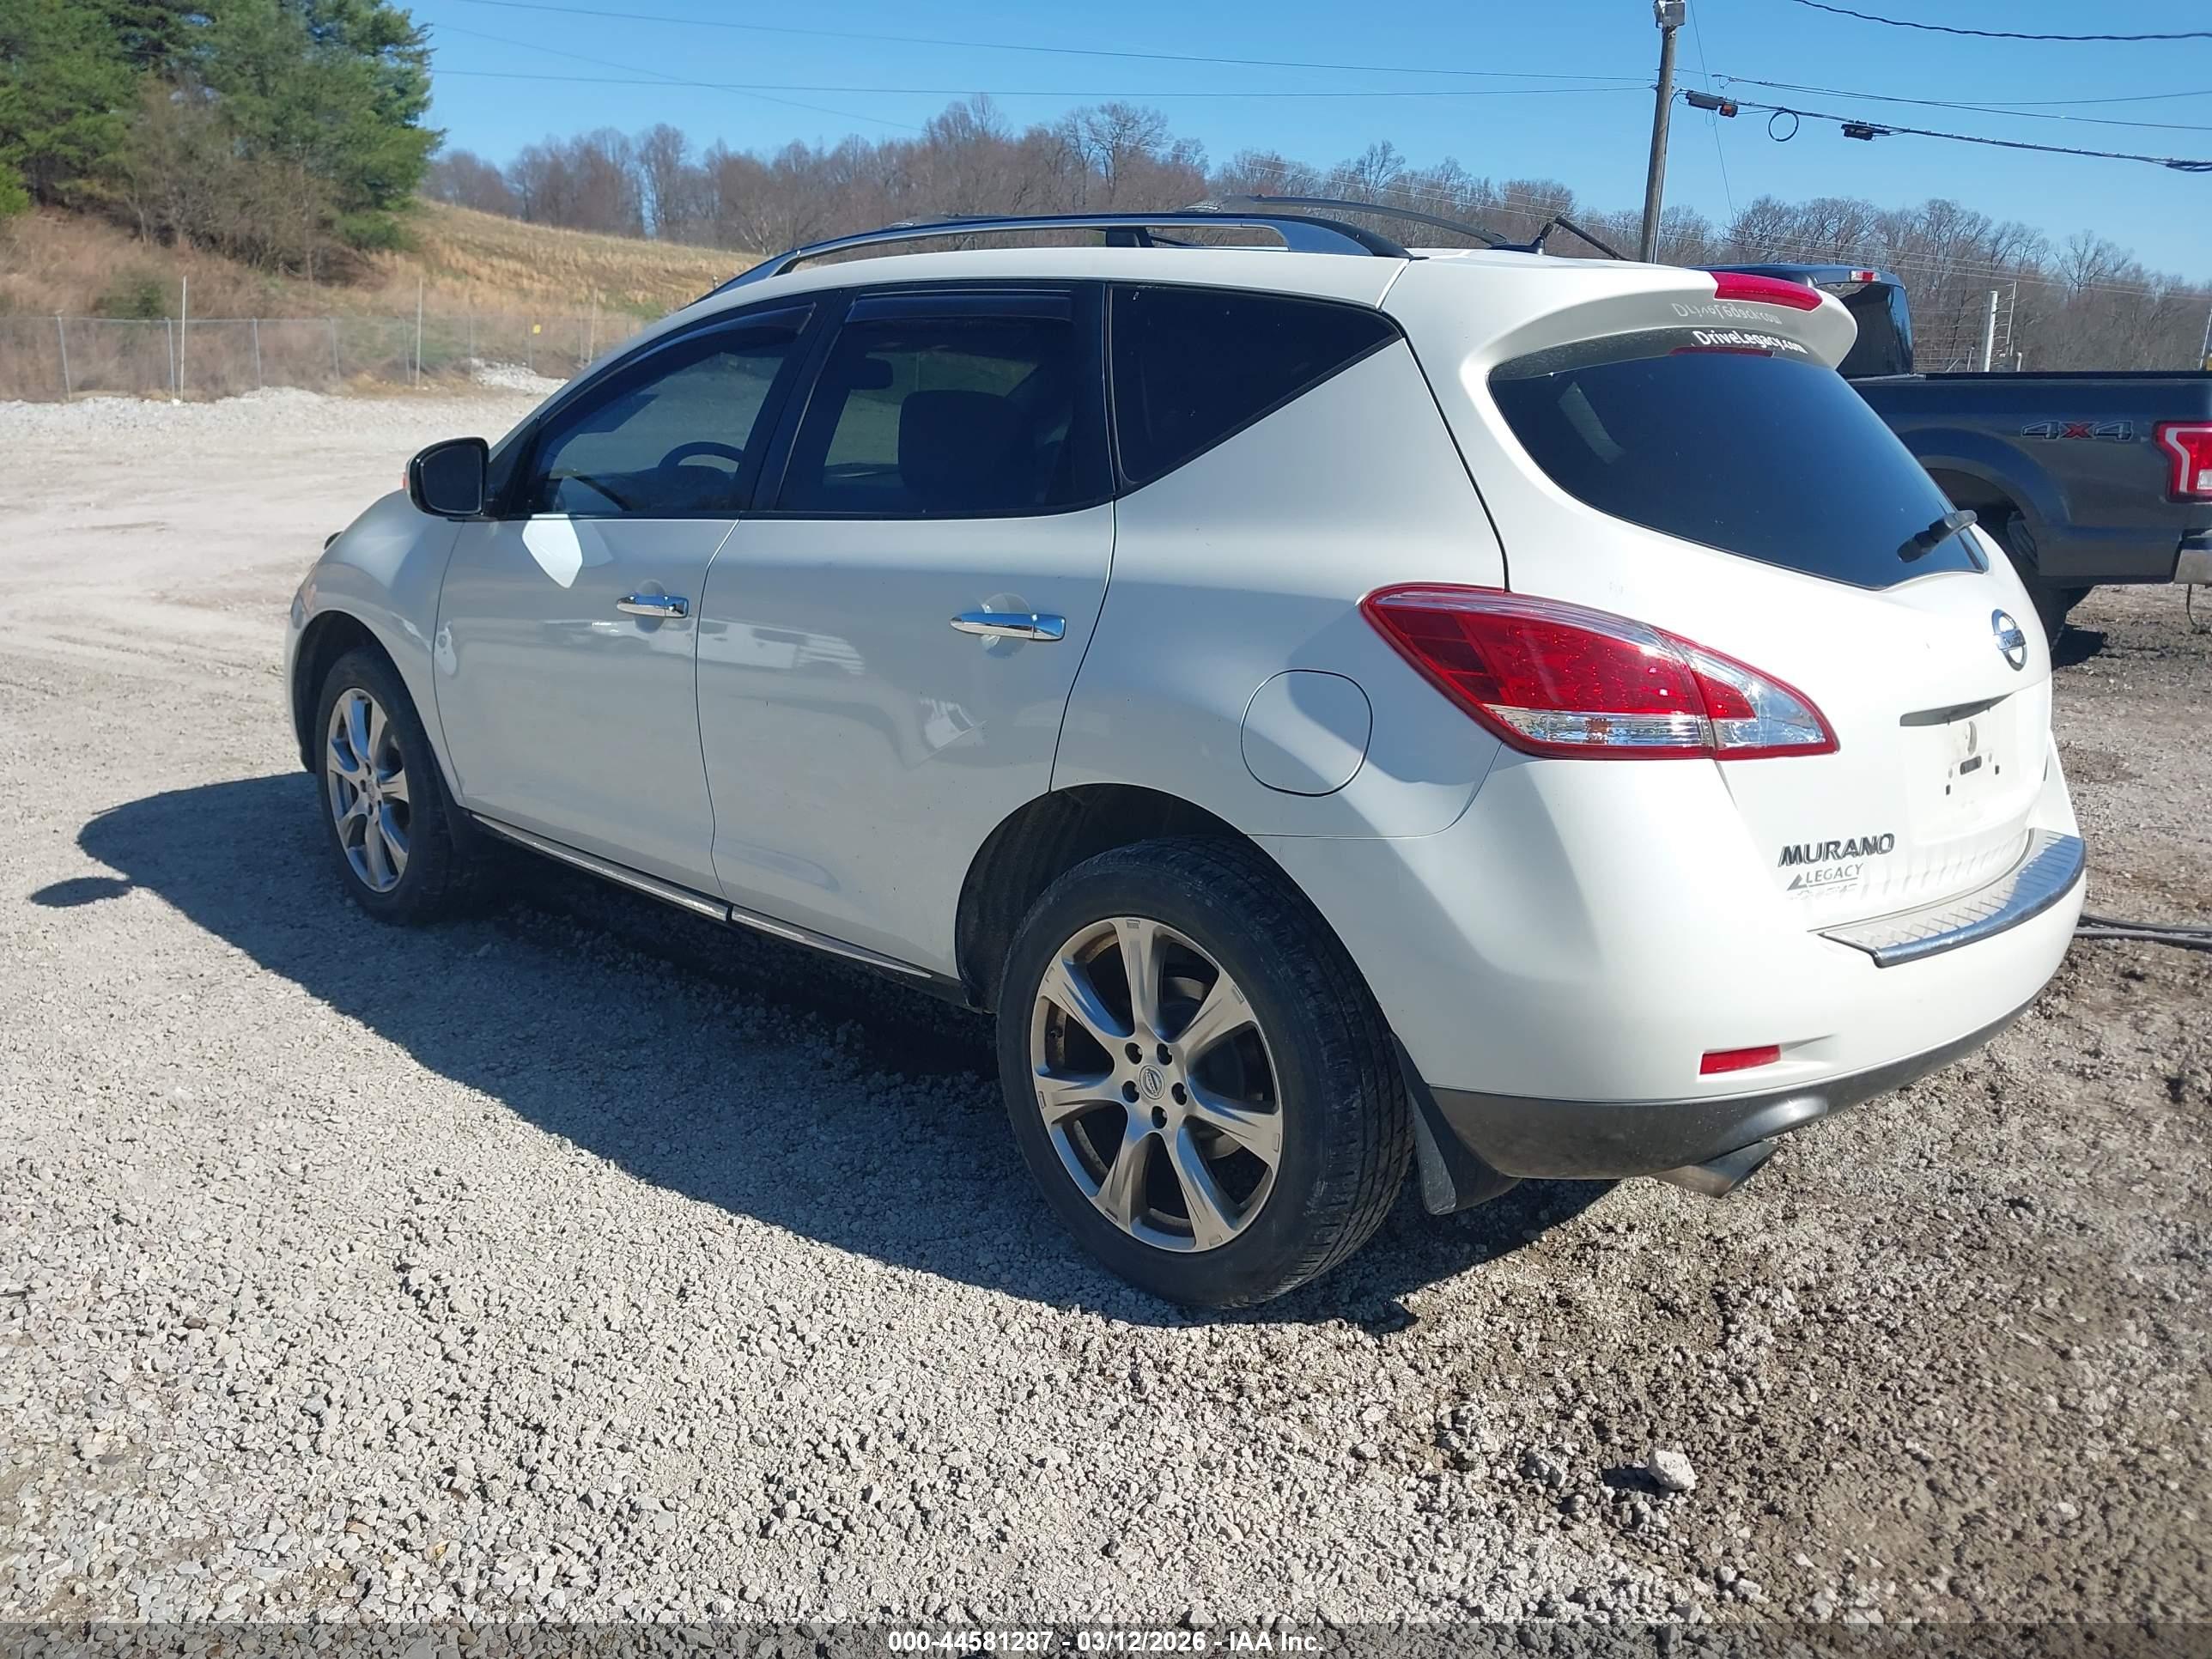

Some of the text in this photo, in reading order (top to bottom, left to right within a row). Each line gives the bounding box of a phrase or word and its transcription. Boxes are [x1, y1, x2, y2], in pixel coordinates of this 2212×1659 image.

[1692, 330, 1808, 355] DriveLegacy.com
[1778, 833, 1895, 867] MURANO
[1805, 862, 1864, 884] LEGACY
